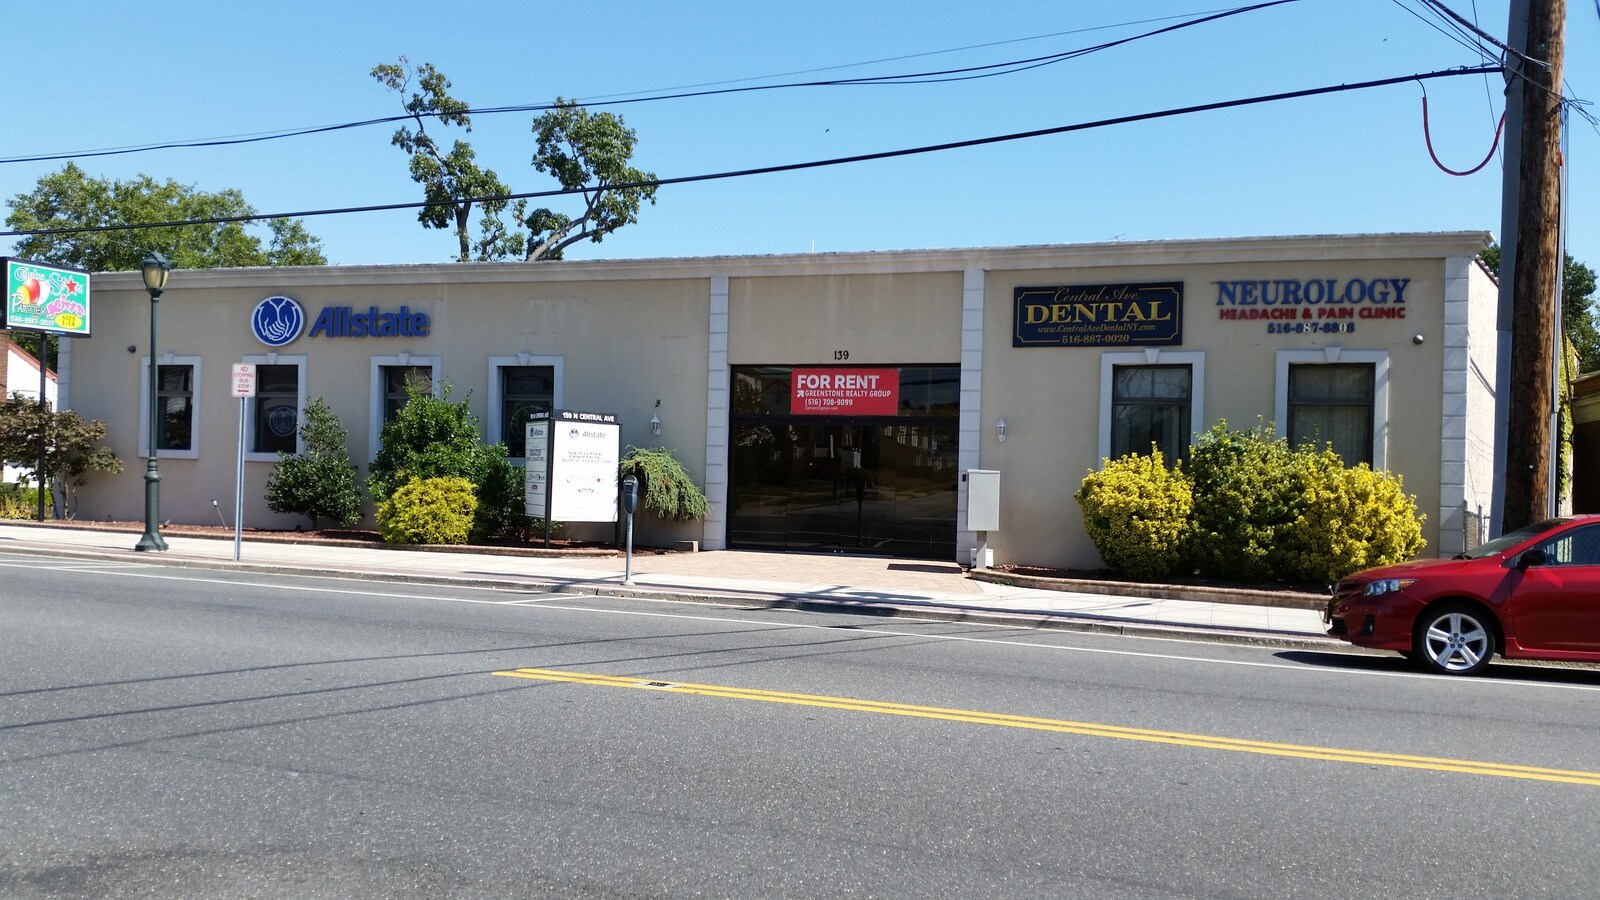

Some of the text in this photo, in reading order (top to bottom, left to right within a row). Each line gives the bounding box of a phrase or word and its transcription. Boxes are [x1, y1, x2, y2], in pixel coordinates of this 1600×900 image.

[1053, 285, 1140, 303] Central Ave.
[1215, 278, 1411, 306] NEUROLOGY
[1024, 301, 1171, 325] DENTAL
[1219, 306, 1407, 320] HEADACHE & PAIN CLINIC
[308, 305, 431, 338] Allstate
[1037, 323, 1156, 334] www.CentralAveDentalNY.com
[1062, 334, 1130, 344] 516-887-0020
[834, 350, 849, 360] 139
[797, 374, 880, 389] FOR RENT
[845, 390, 868, 398] REALTY
[804, 398, 853, 407] (516) 708-9099
[579, 413, 603, 422] CENTRAL
[603, 415, 615, 423] AVE
[582, 431, 607, 439] Allstate
